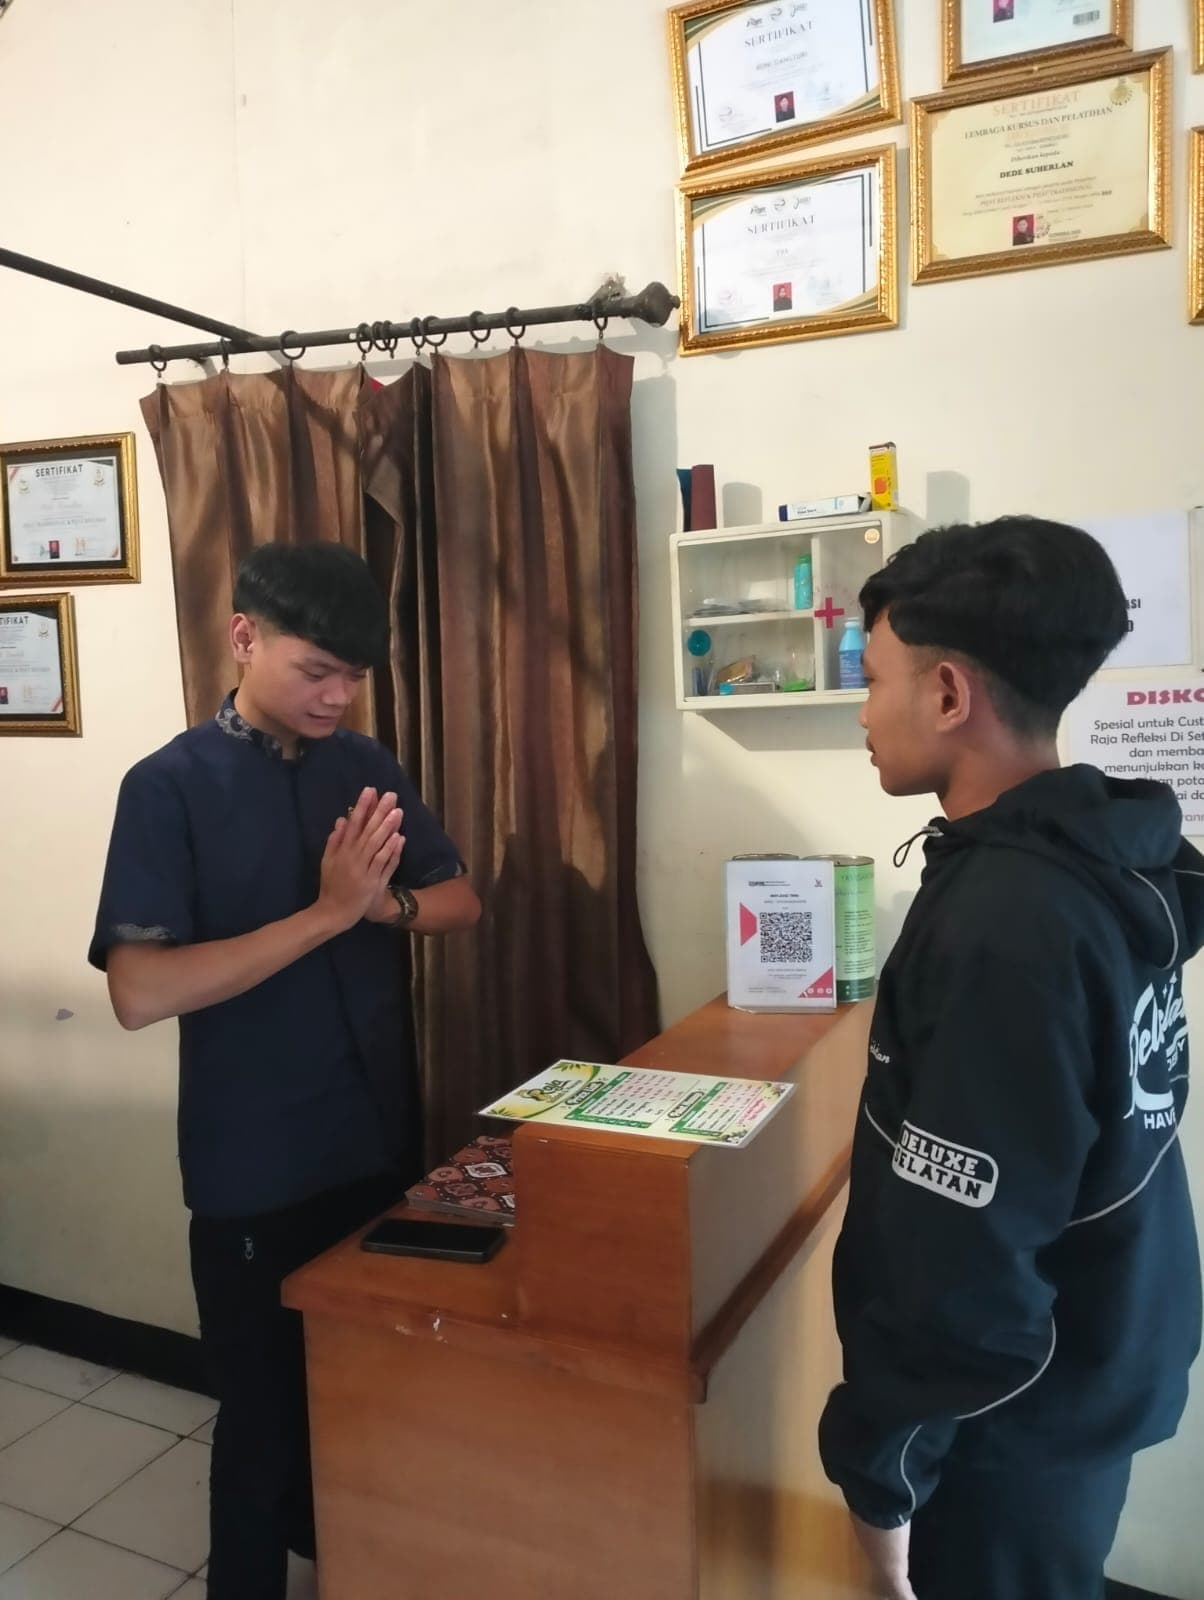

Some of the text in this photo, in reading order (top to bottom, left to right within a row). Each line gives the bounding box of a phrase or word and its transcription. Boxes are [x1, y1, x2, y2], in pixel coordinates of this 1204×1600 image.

[744, 20, 814, 47] SERTIFIKAT
[992, 90, 1081, 117] SERTIFIKAT
[964, 125, 1005, 140] LEMBAGA
[1006, 119, 1040, 133] KURSUS
[1041, 116, 1060, 127] DAN
[1061, 106, 1115, 123] PELATIHAN
[999, 160, 1075, 179] DEDE SUHERLAN
[746, 214, 815, 235] SERTIFIKAT
[35, 464, 84, 477] SERTIFIKAT
[1094, 718, 1134, 732] Spesial
[1137, 717, 1175, 729] untuk
[1090, 734, 1118, 745] Raja
[1121, 732, 1167, 743] Refleksi
[1170, 731, 1184, 742] Di
[1129, 747, 1153, 758] dan
[1104, 761, 1189, 773] menunjukkan
[901, 1128, 979, 1176] DELUXE
